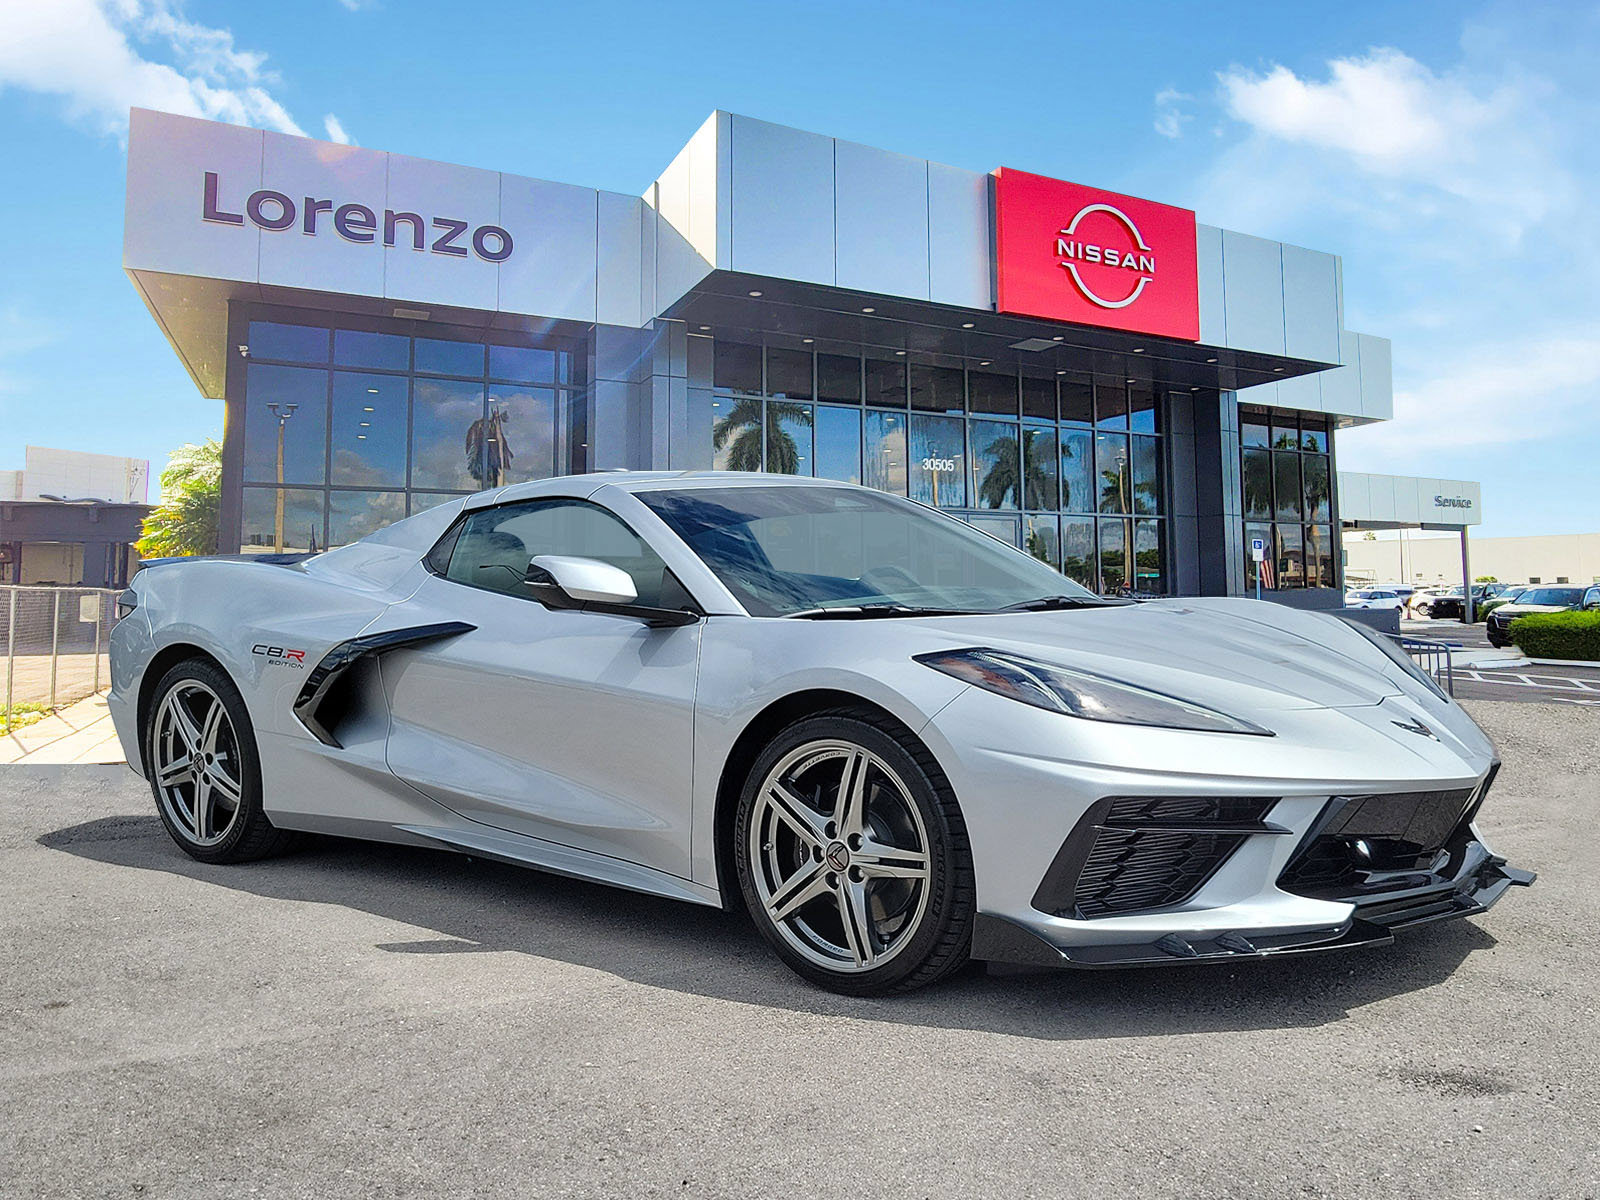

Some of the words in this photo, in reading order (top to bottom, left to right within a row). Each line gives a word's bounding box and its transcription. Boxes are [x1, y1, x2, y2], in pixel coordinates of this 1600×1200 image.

[202, 171, 514, 262] Lorenzo
[1057, 238, 1155, 273] NISSAN
[922, 457, 954, 472] 30505
[1434, 495, 1472, 508] Service
[268, 659, 304, 669] EDITION
